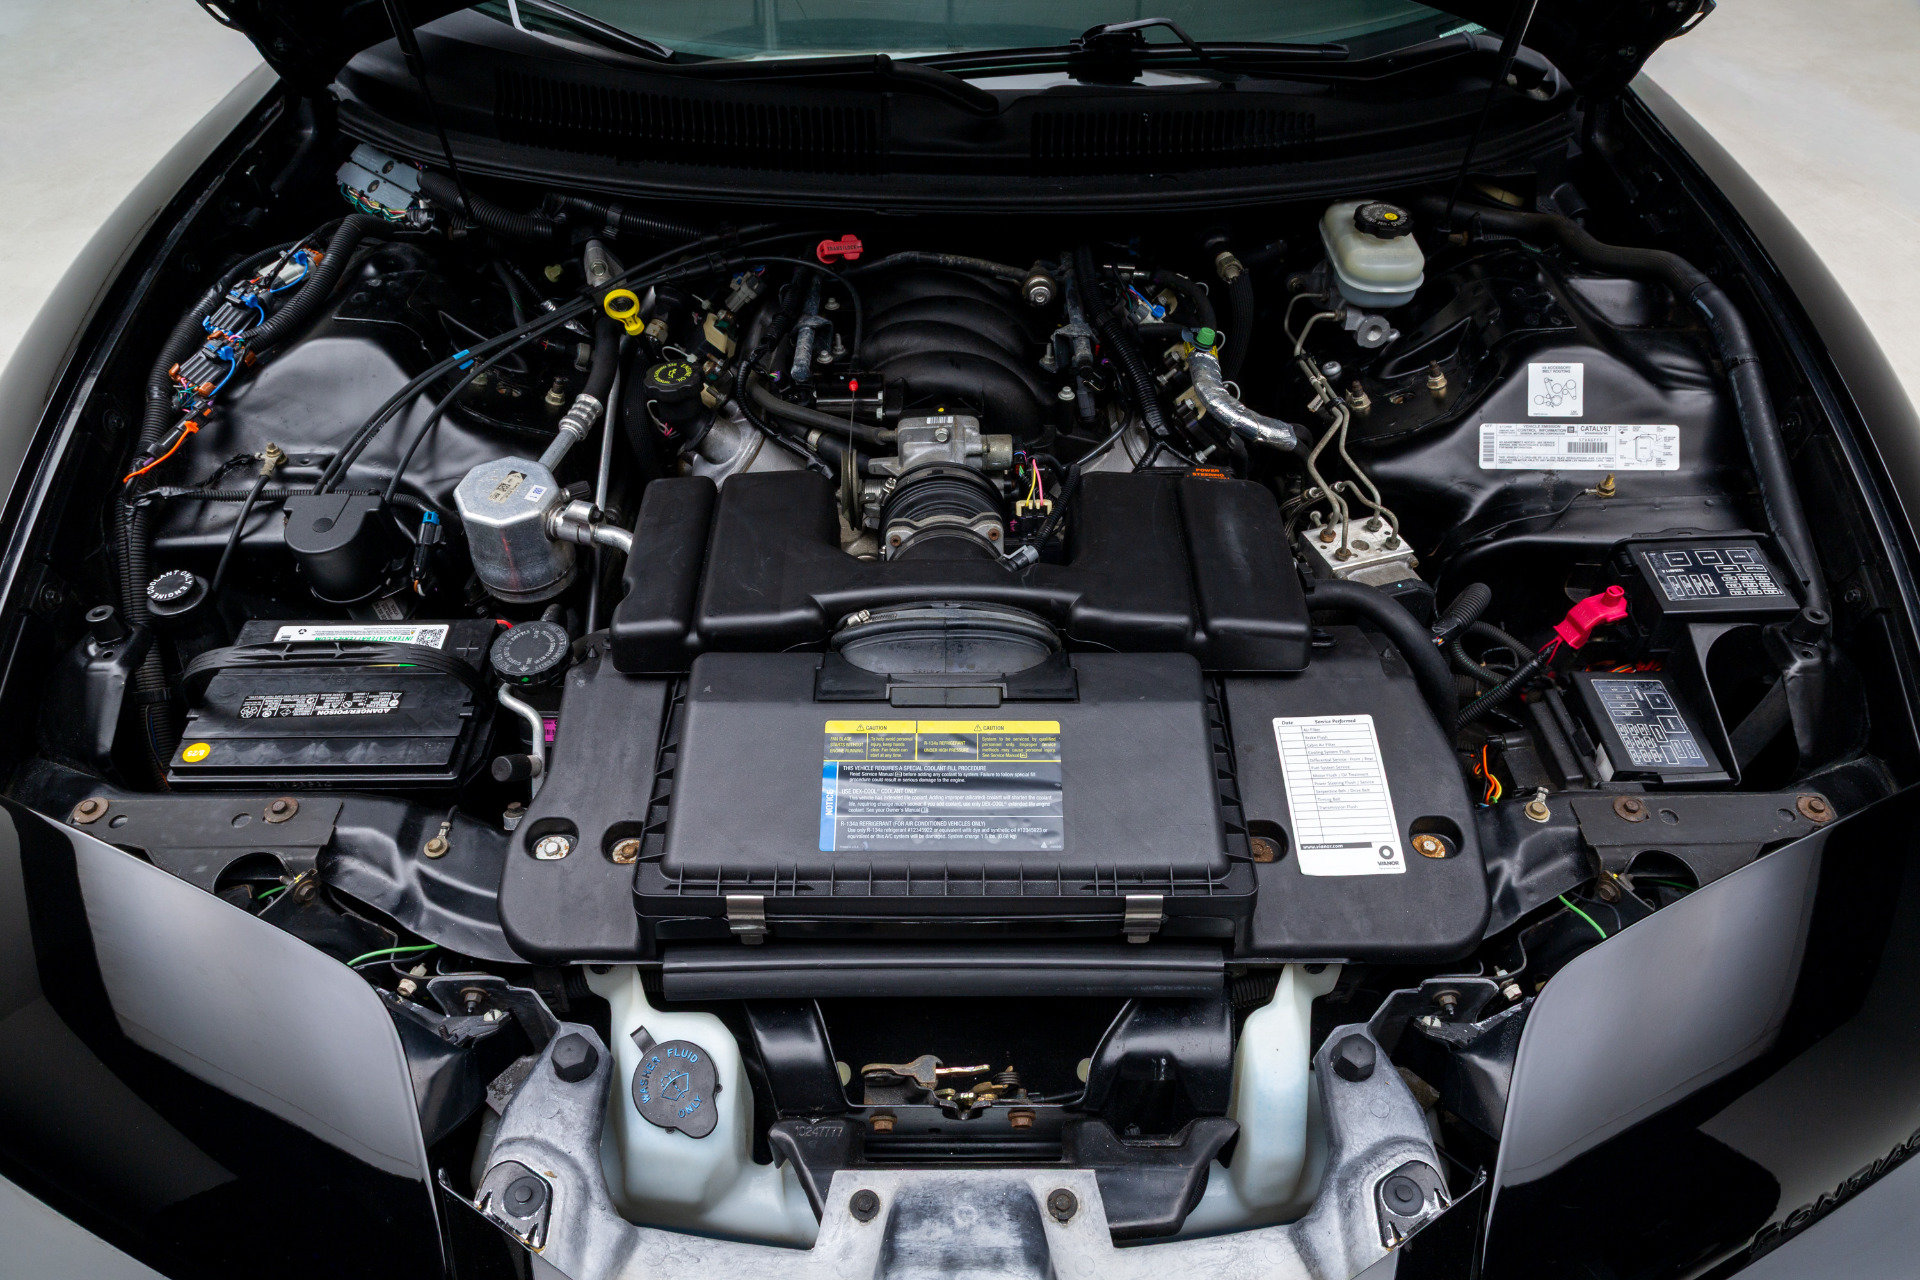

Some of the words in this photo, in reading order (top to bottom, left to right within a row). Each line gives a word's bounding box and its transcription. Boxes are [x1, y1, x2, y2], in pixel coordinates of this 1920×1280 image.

[147, 570, 179, 594] COOLANT
[180, 571, 193, 584] ONLY
[151, 586, 188, 599] ENGINE
[825, 789, 834, 815] NOTICE
[667, 1048, 698, 1063] FLUID
[640, 1056, 660, 1104] WASHER
[678, 1095, 702, 1118] ONLY
